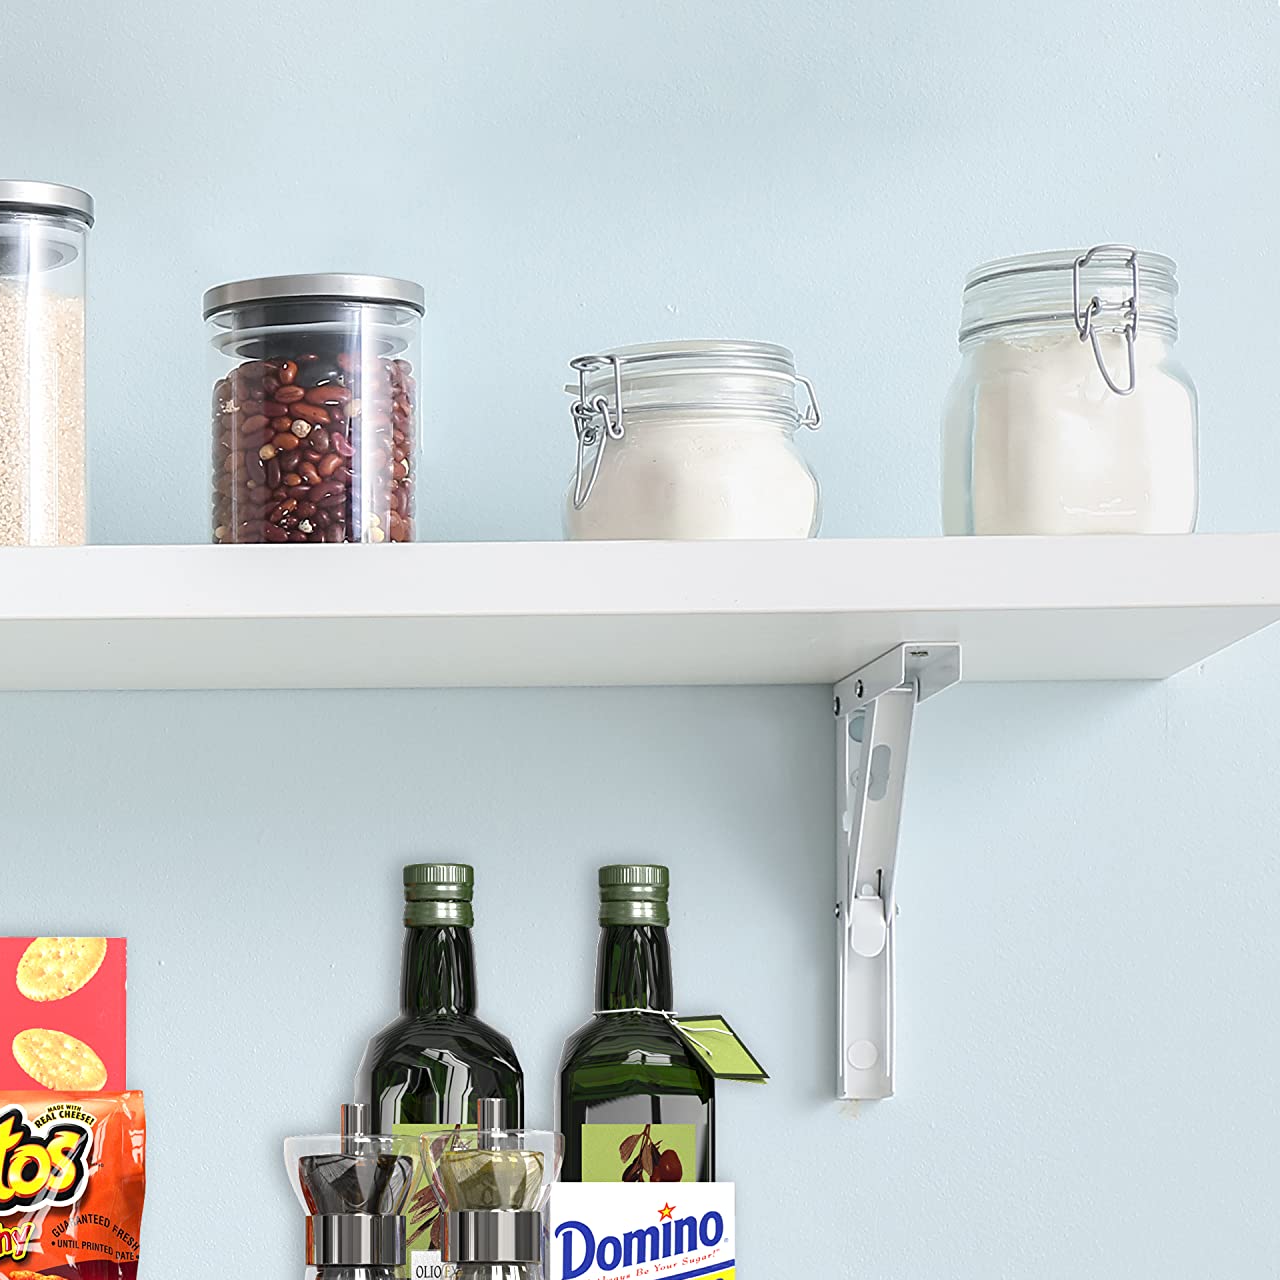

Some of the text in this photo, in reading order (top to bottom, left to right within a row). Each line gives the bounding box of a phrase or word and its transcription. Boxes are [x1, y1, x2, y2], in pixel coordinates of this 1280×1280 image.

[47, 1104, 82, 1113] MADE WITH
[34, 1110, 95, 1128] REAL CHEESE!
[111, 1223, 140, 1251] FRESH
[554, 1211, 724, 1280] Domino
[57, 1239, 135, 1260] UNTIL PRINTED DATE
[415, 1265, 442, 1278] OLIO
[636, 1267, 650, 1277] Be
[654, 1262, 678, 1273] Your
